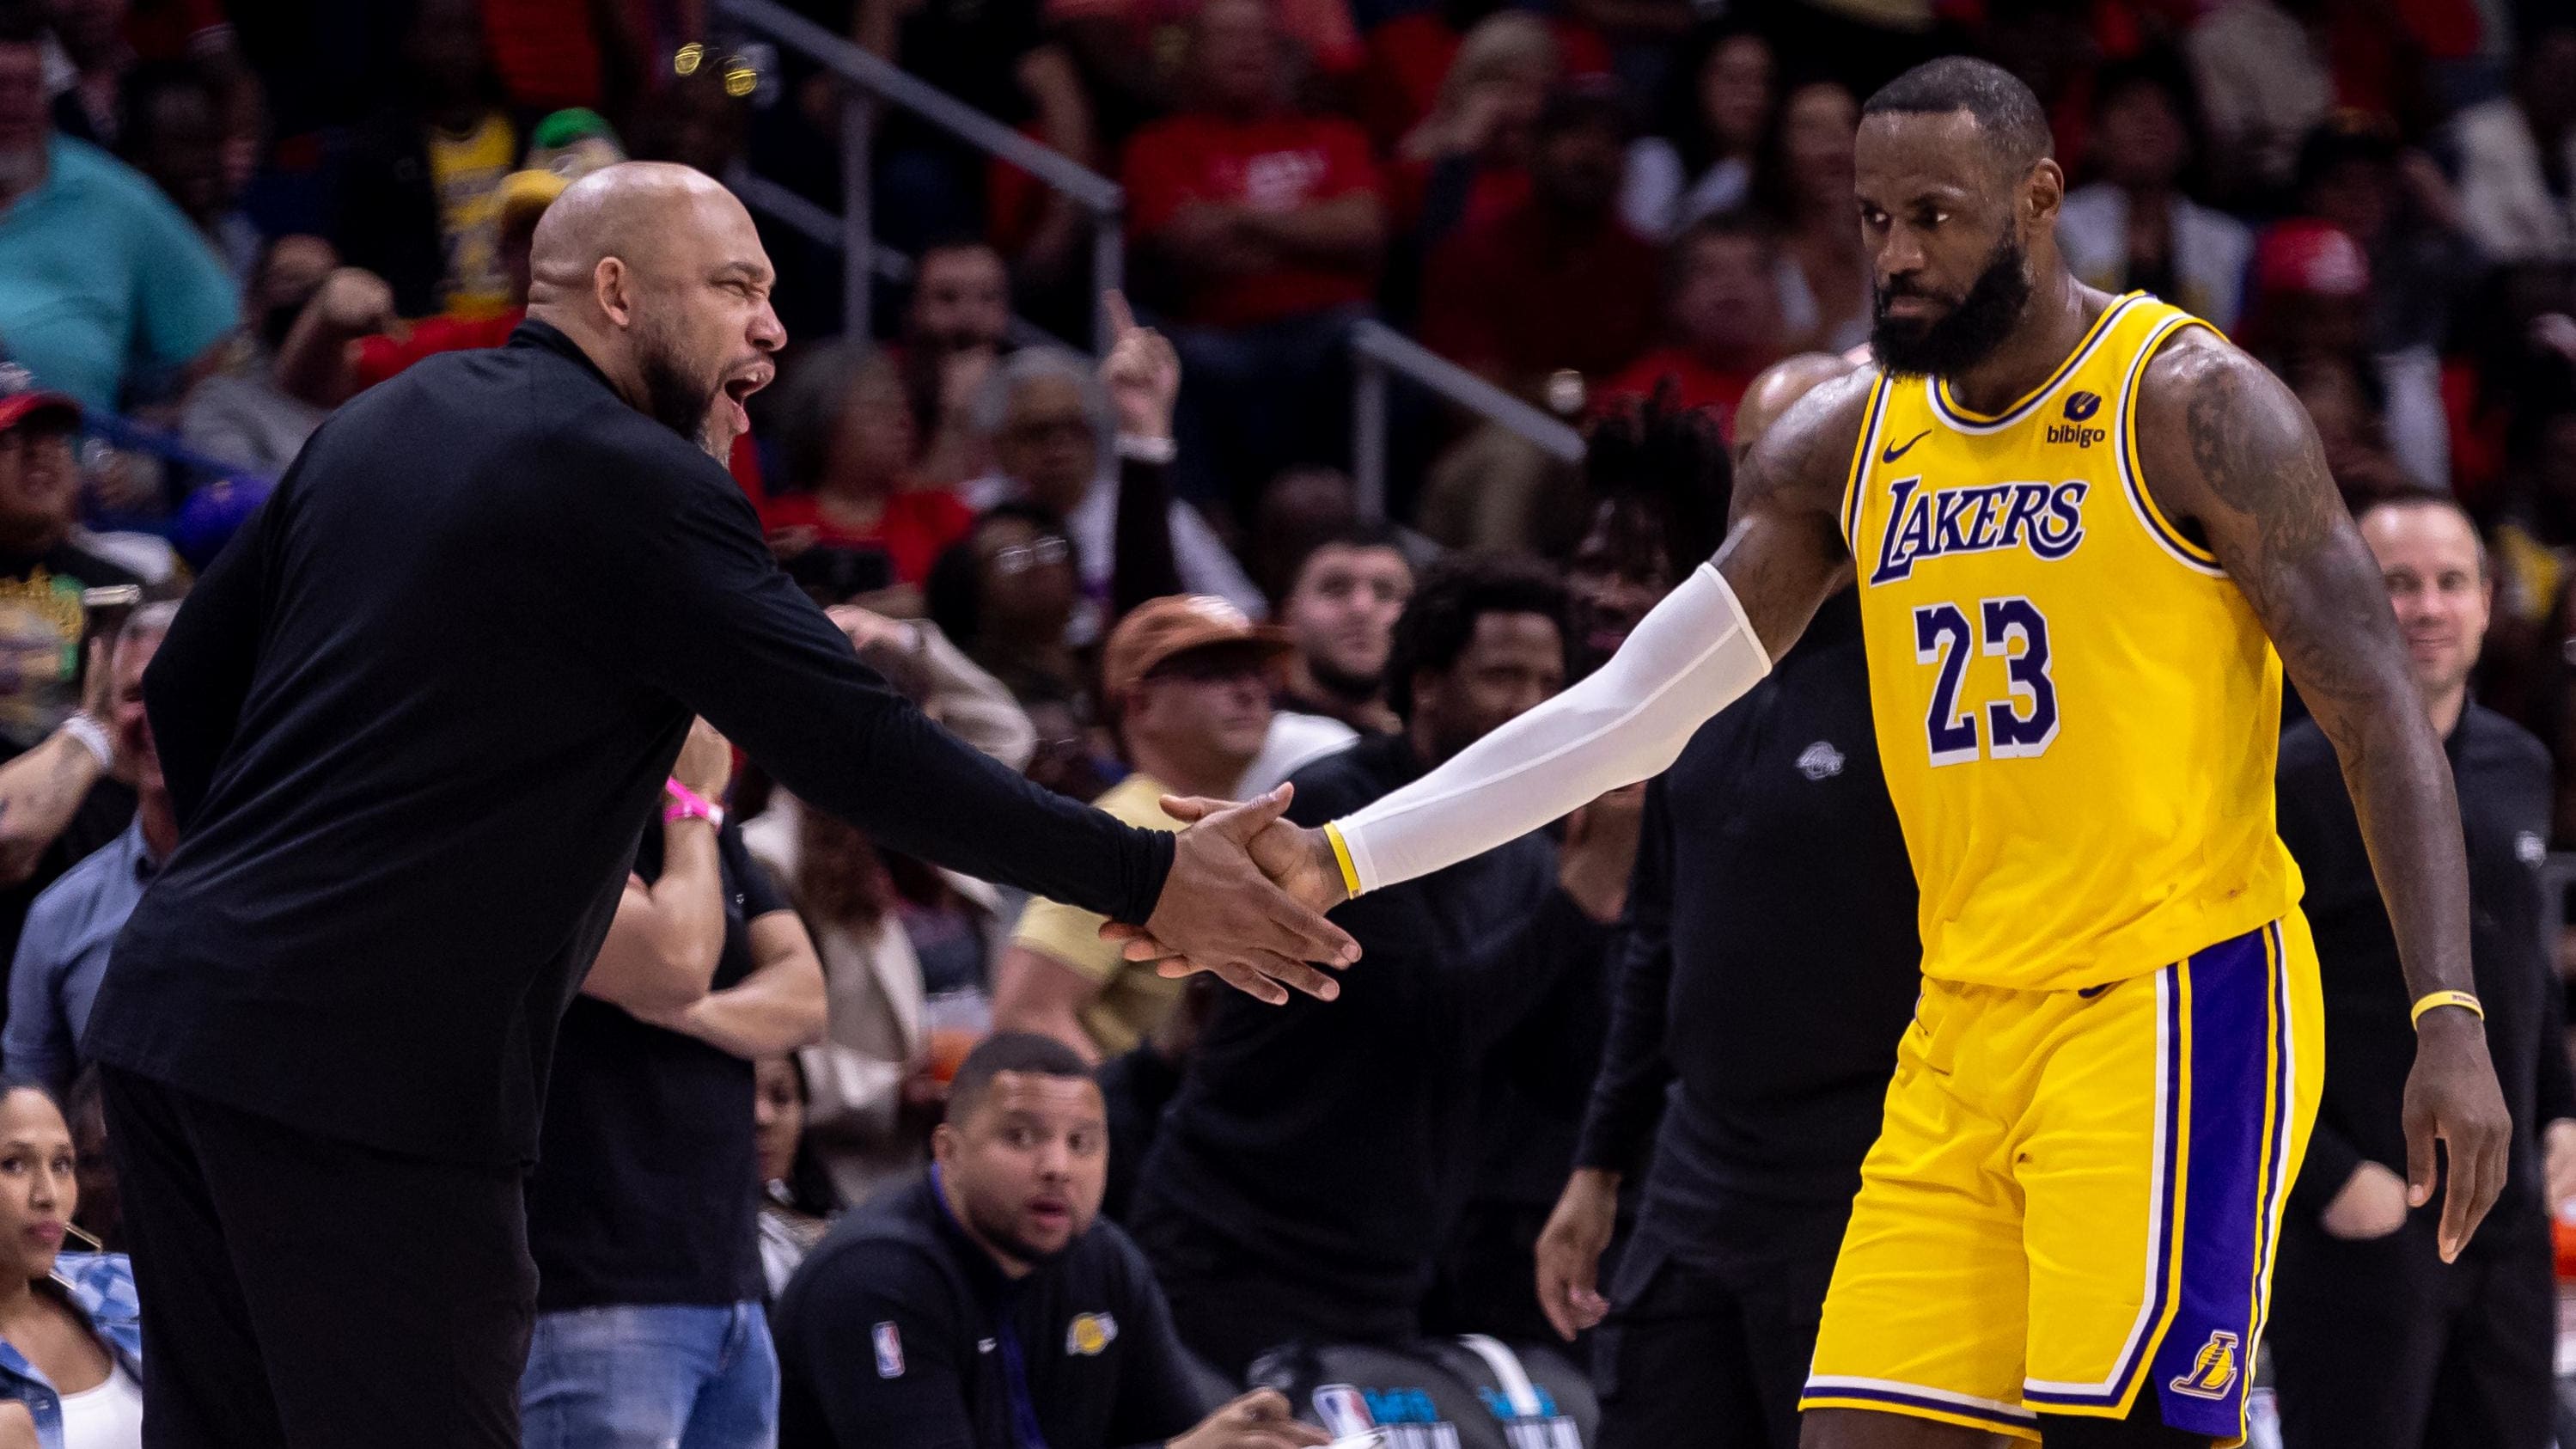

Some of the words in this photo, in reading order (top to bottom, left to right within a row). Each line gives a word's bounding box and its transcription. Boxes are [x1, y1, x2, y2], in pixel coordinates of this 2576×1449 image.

[2048, 424, 2106, 449] bibigo
[1870, 474, 2090, 586] LAKERS
[1912, 595, 2061, 768] 23
